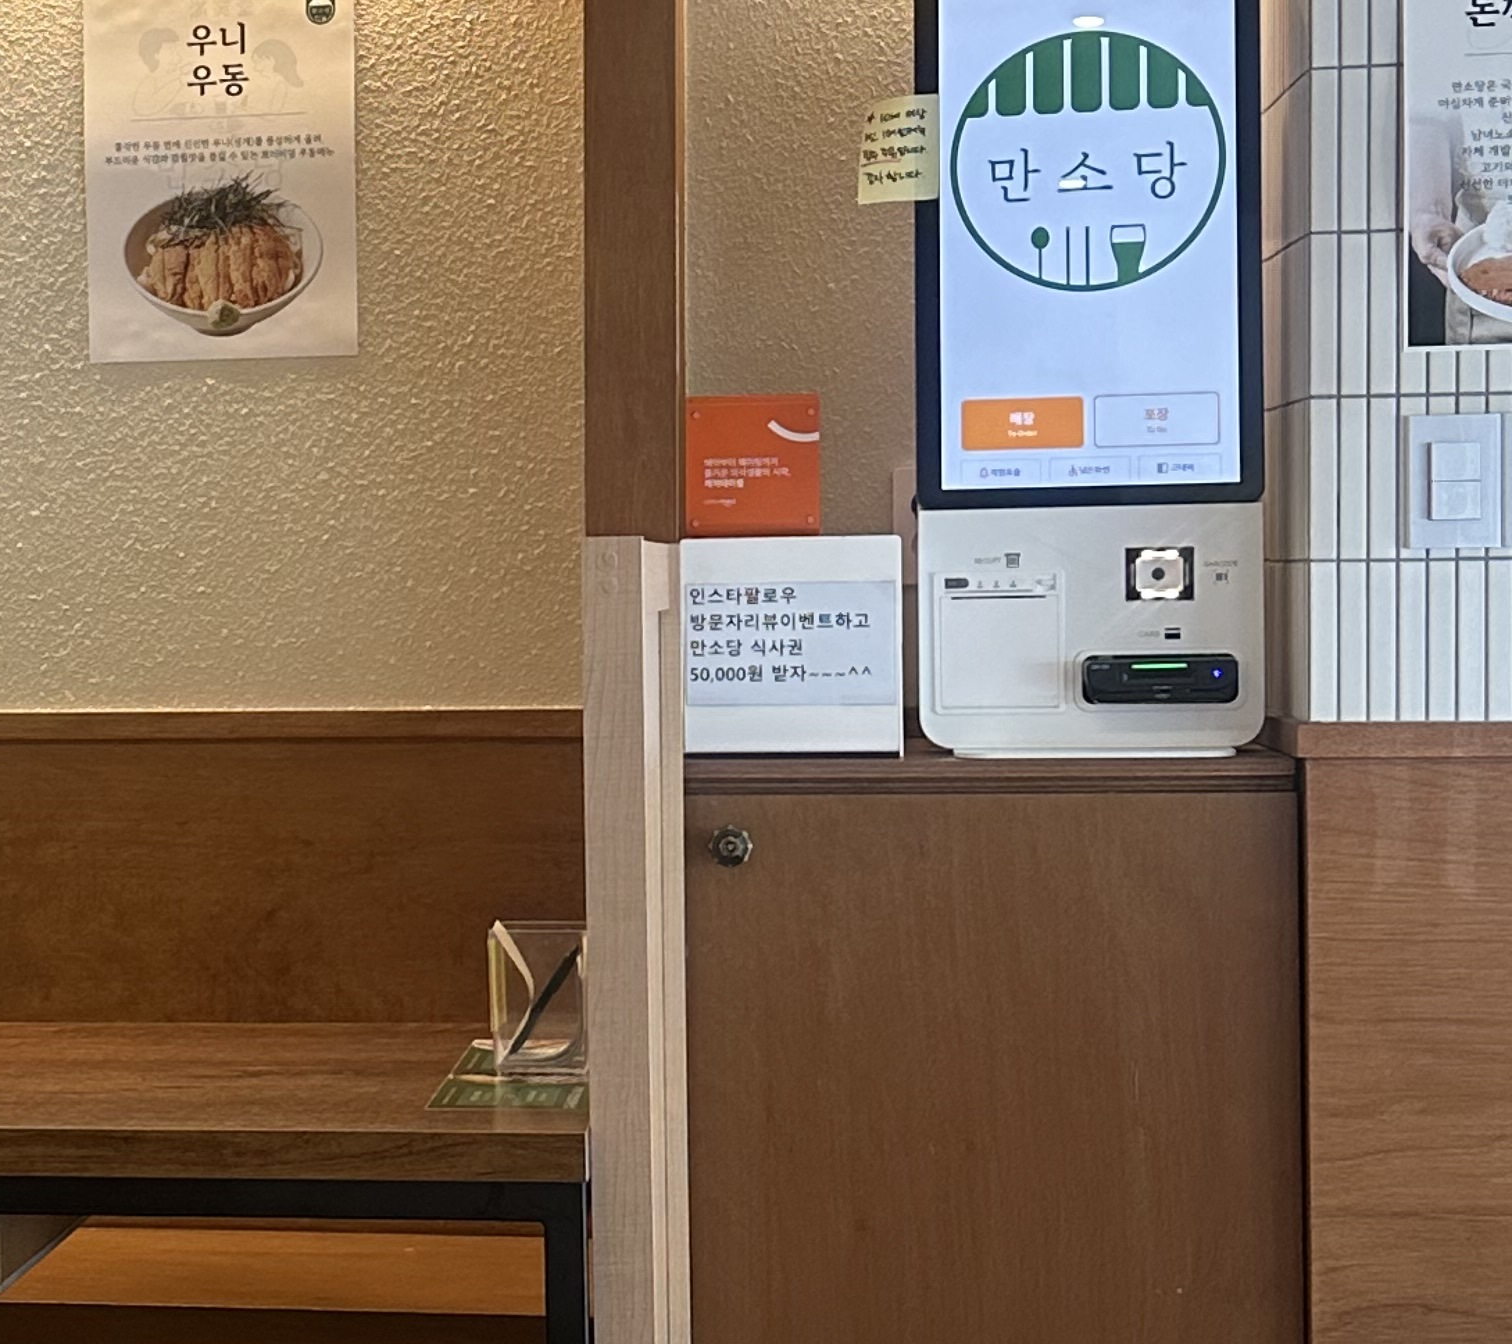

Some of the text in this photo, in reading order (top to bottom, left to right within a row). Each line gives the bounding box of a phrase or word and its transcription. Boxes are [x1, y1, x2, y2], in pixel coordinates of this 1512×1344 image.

[186, 21, 245, 56] 우니
[187, 63, 249, 96] 우동
[1144, 407, 1169, 421] 포장
[689, 586, 797, 606] 인스타팔로우
[689, 612, 871, 632] 방문자리뷰이벤트하고
[689, 638, 804, 657] 만소당 식사권
[689, 664, 763, 683] 50,000원
